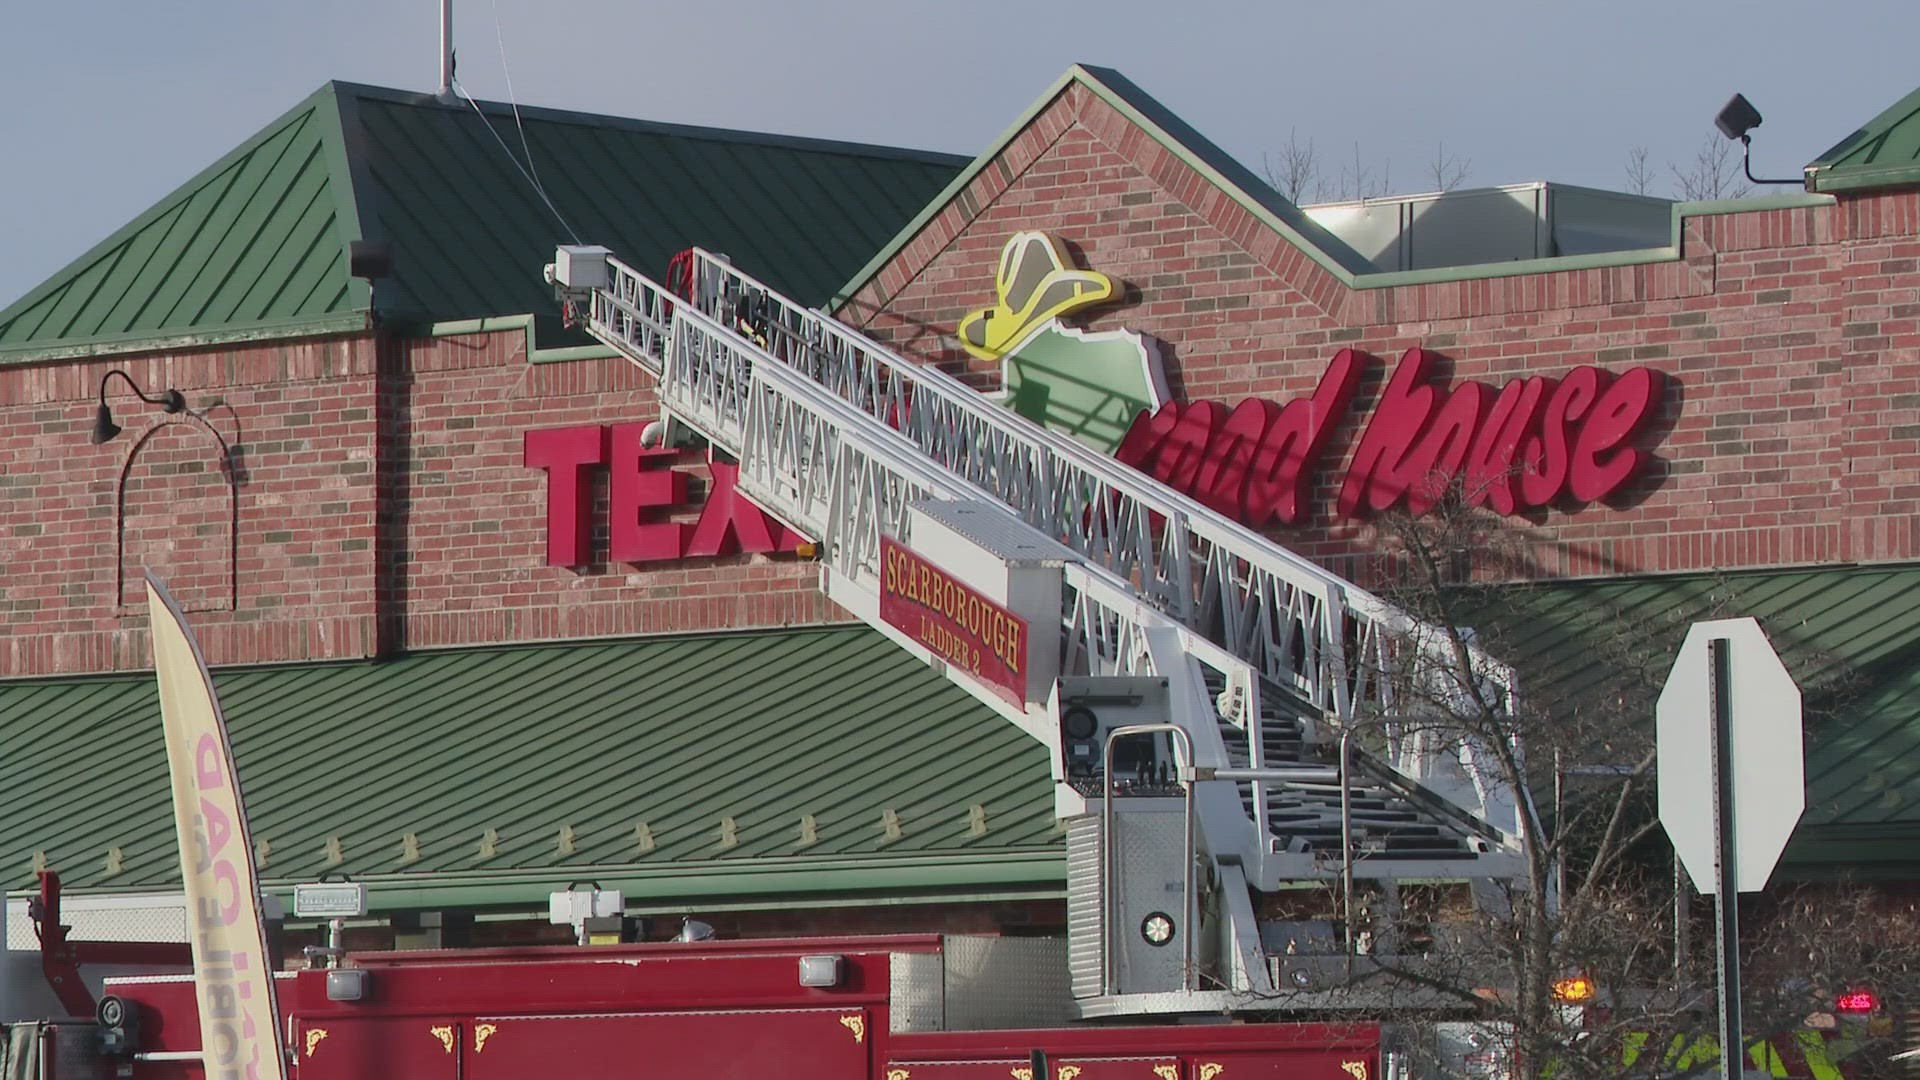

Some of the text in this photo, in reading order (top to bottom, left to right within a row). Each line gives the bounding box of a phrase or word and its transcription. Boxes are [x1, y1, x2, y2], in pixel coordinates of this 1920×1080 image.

[524, 419, 805, 568] TEX
[886, 545, 1020, 674] SCARBOROUGH
[920, 615, 982, 676] LADDER 2
